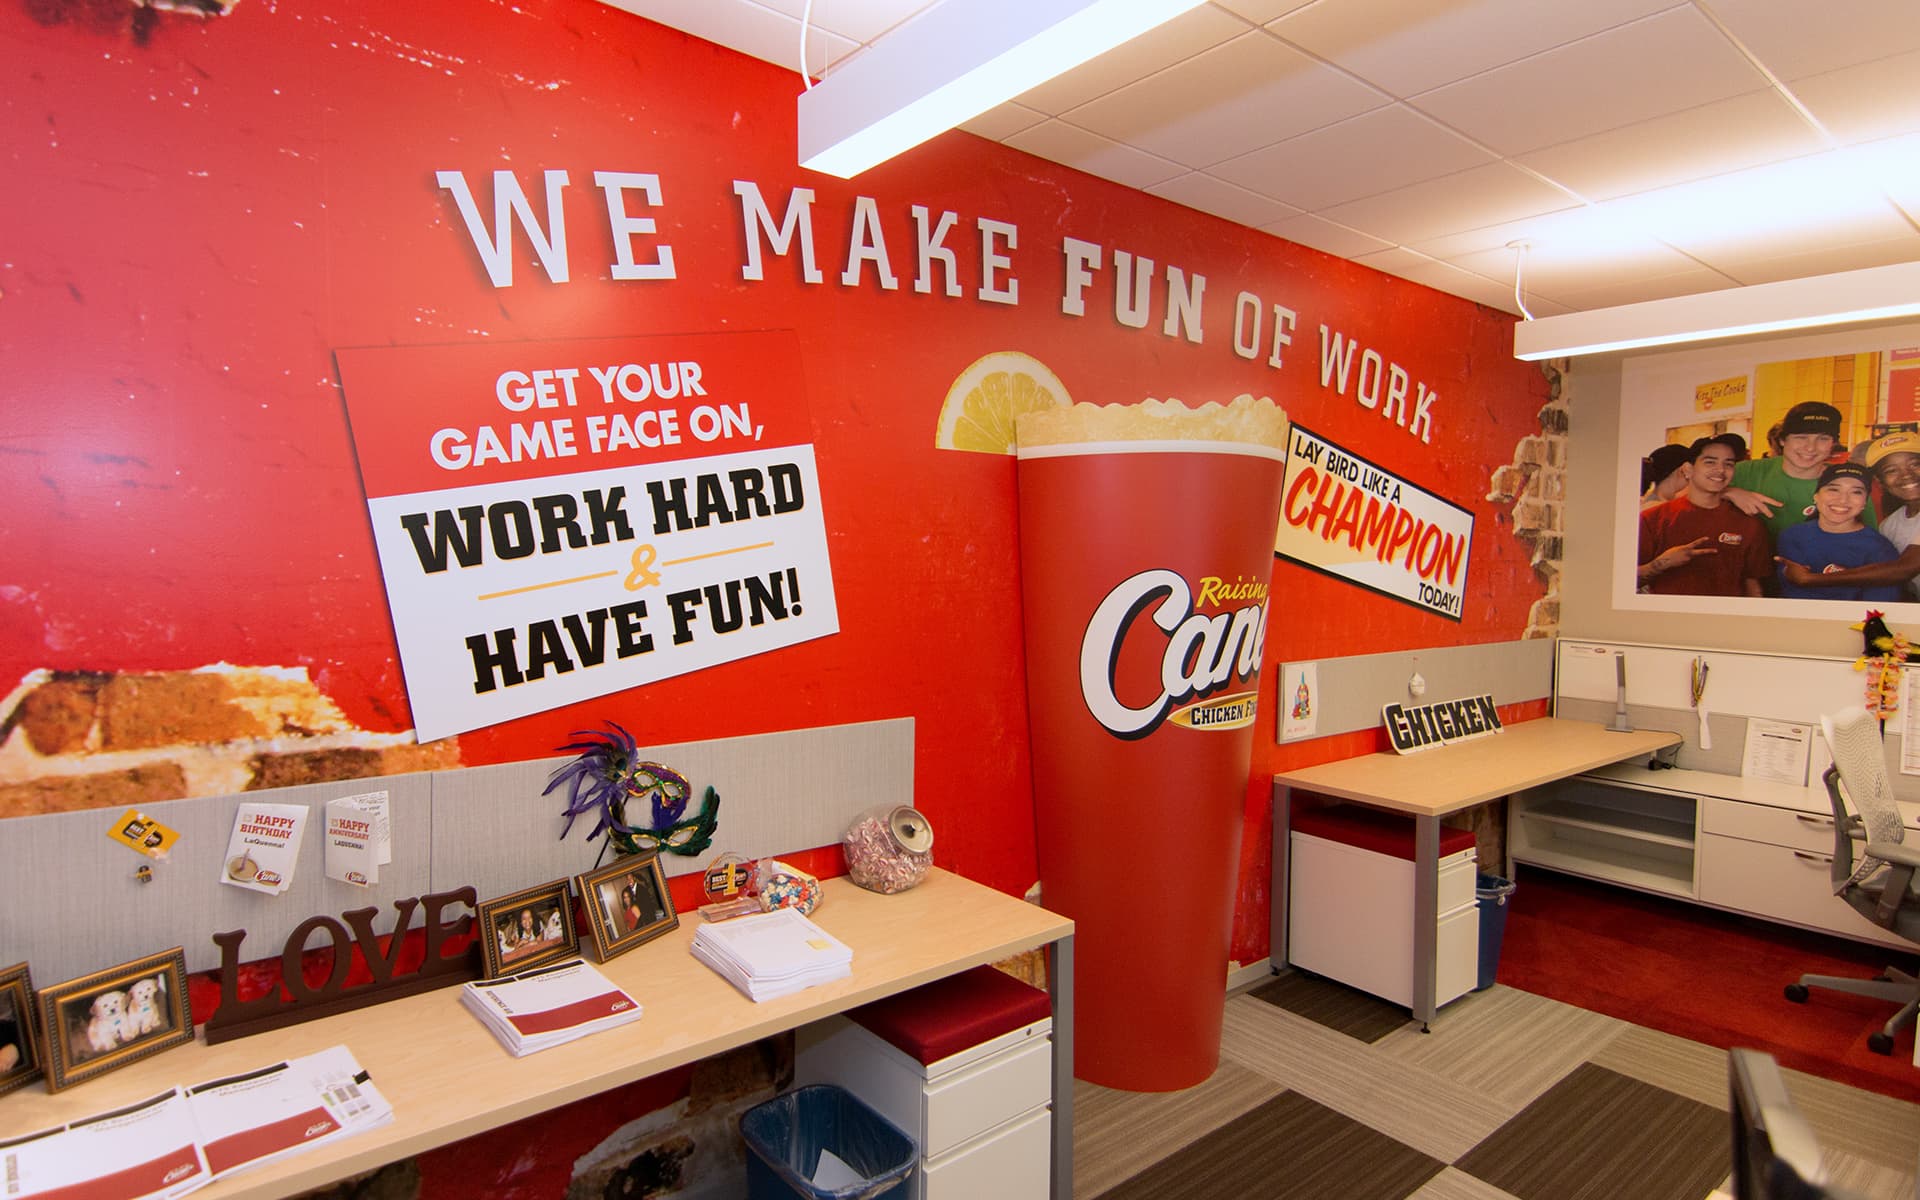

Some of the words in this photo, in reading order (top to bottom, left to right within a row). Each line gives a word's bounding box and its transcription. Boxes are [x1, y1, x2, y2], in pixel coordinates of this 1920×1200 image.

[435, 169, 677, 288] WE
[732, 179, 1019, 305] MAKE
[1062, 236, 1206, 344] FUN
[1233, 290, 1297, 369] OF
[1319, 323, 1437, 443] WORK
[496, 368, 580, 412] GET
[587, 361, 707, 403] YOUR
[430, 419, 577, 470] GAME
[586, 410, 681, 454] FACE
[689, 402, 764, 441] ON,
[1294, 435, 1324, 465] LAY
[1326, 451, 1359, 482] BIRD
[1361, 468, 1390, 498] LIKE
[1390, 484, 1401, 504] A
[401, 486, 635, 575] WORK
[646, 463, 805, 535] HARD
[1284, 466, 1466, 587] CHAMPION
[623, 543, 662, 592] &
[1195, 575, 1268, 608] Raising
[1417, 582, 1460, 614] TODAY!
[465, 599, 655, 695] HAVE
[666, 567, 804, 647] FUN!
[1190, 704, 1243, 725] CHICKEN
[1385, 694, 1502, 751] CHICKEN
[239, 823, 293, 840] BIRTHDAY
[254, 813, 296, 829] HAPPY
[339, 818, 370, 833] HAPPY
[212, 885, 478, 1013] LOVE
